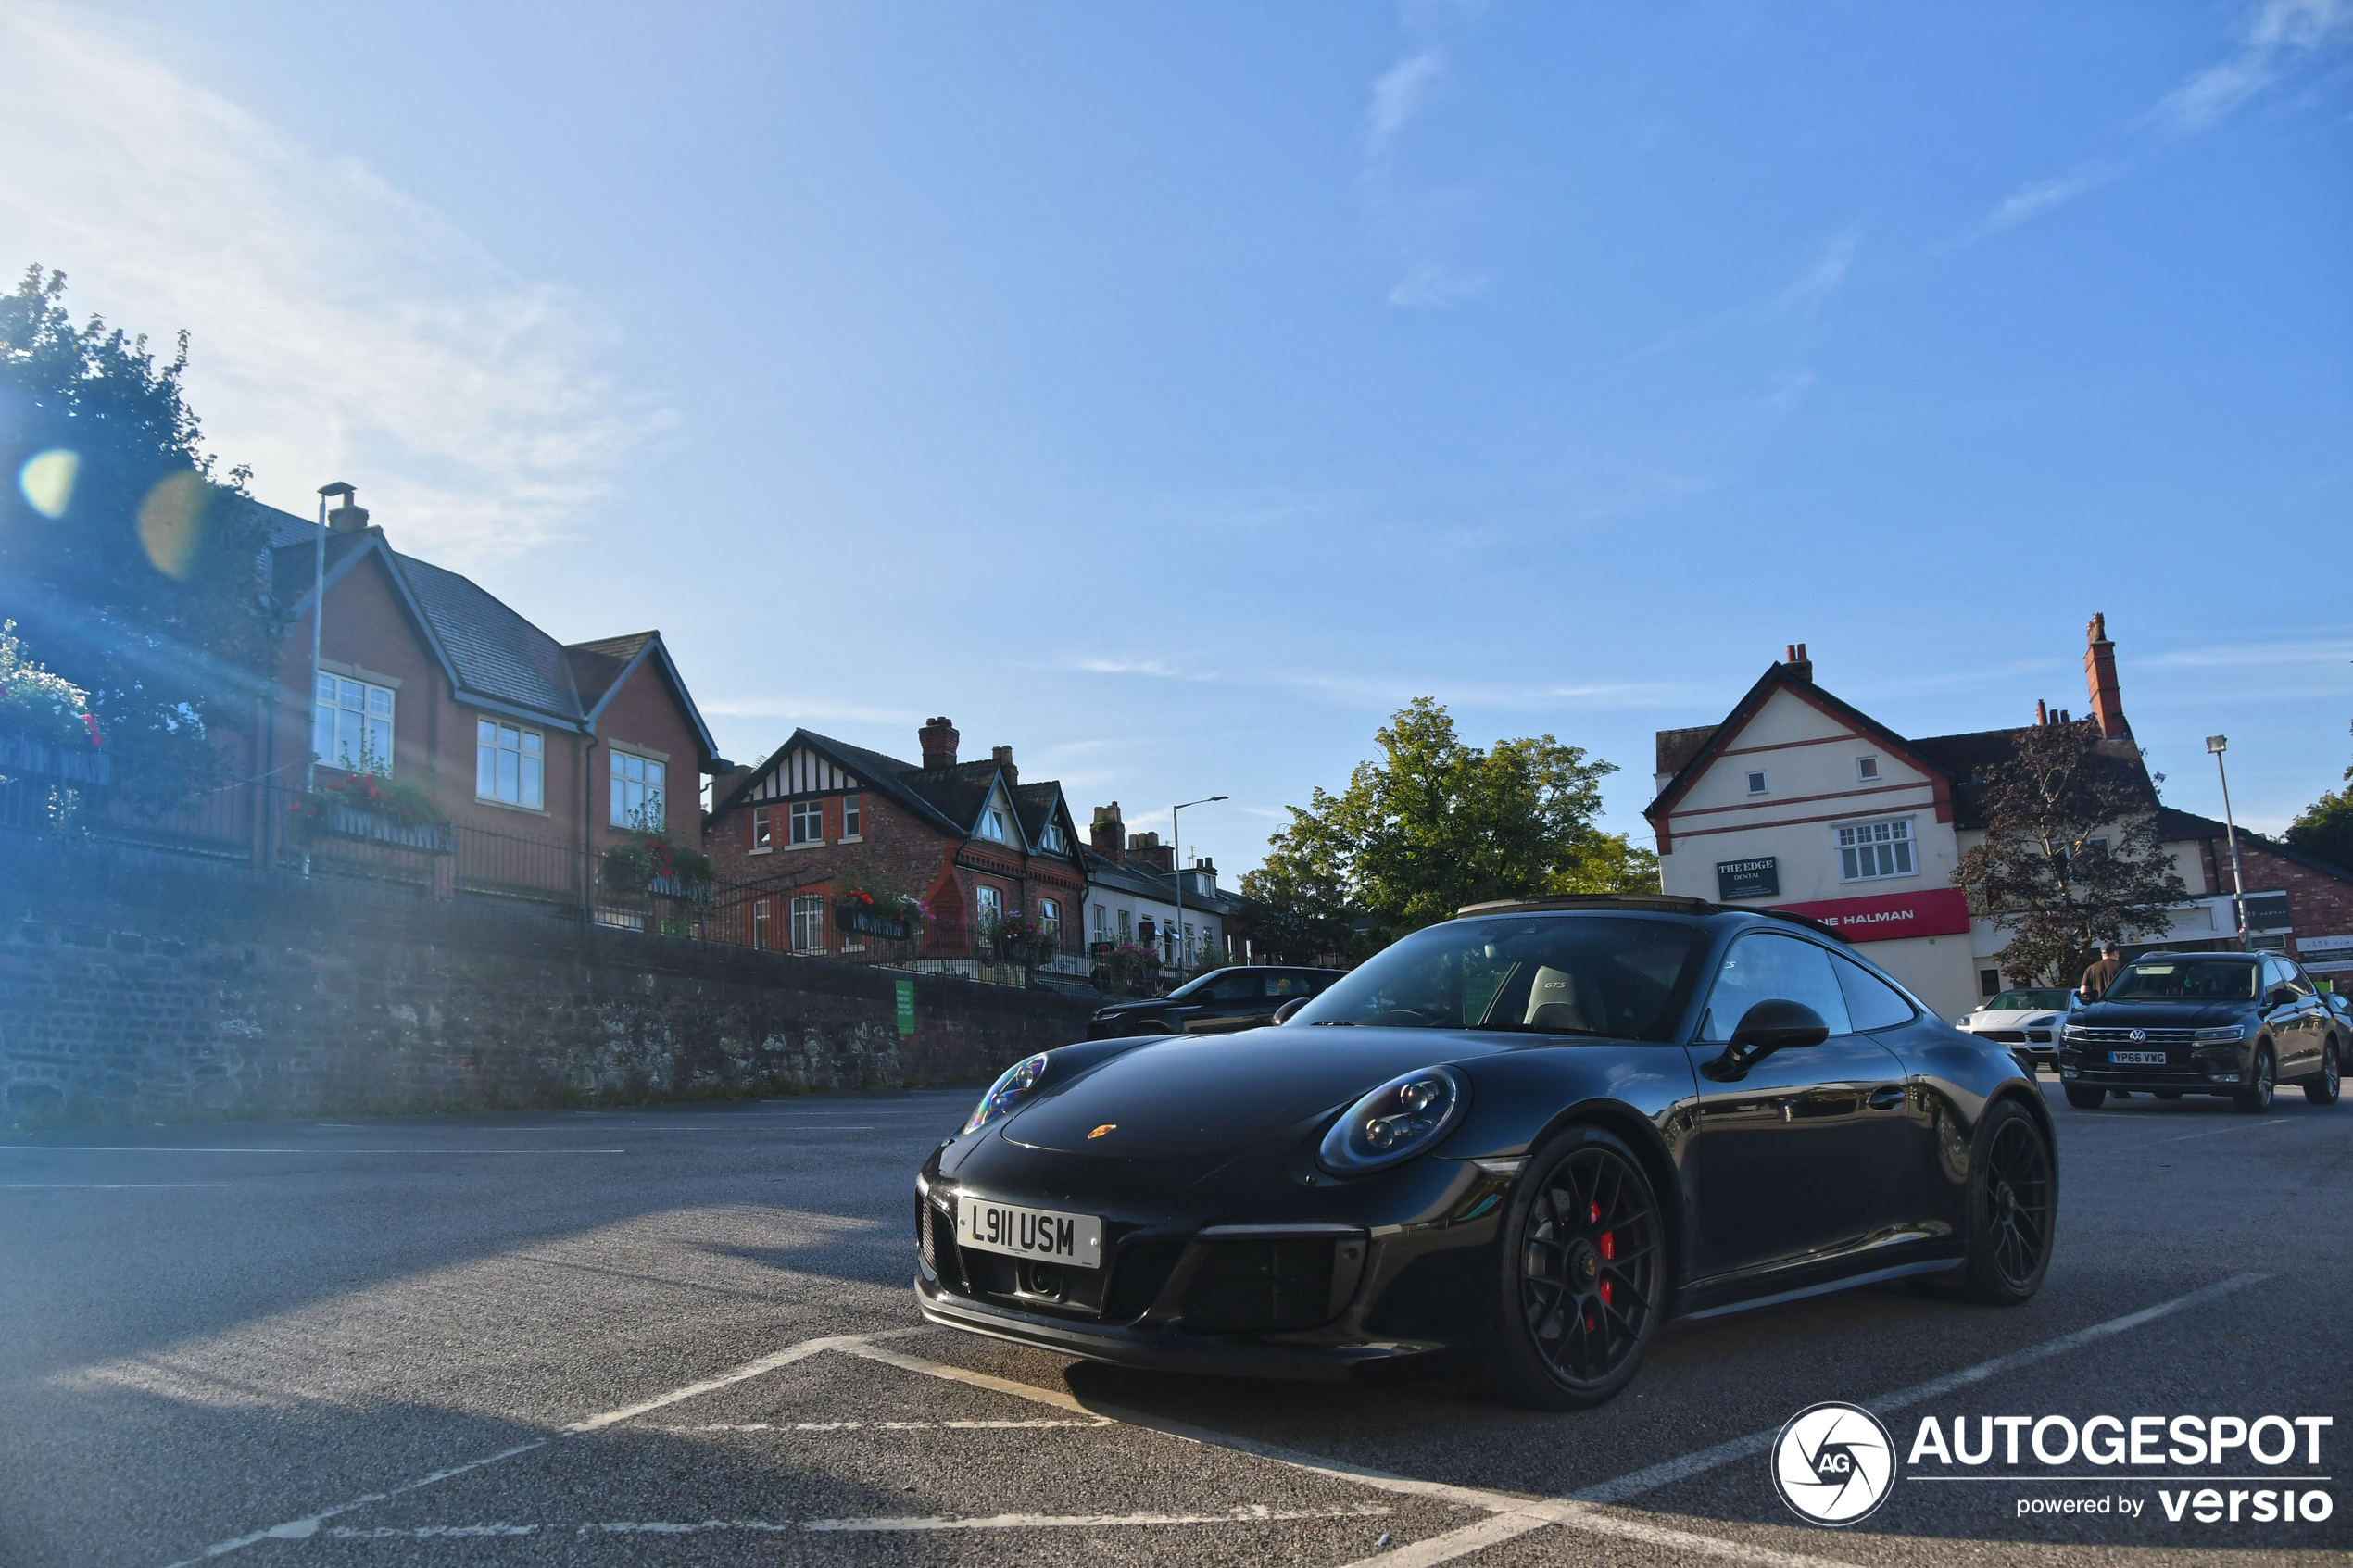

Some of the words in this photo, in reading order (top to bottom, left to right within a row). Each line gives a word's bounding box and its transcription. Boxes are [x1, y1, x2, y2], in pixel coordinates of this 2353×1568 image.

[1718, 863, 1743, 874] THE
[1743, 859, 1773, 872] EDGE
[1733, 872, 1761, 881] DENTAL
[1843, 909, 1914, 925] HALMAN
[2114, 1053, 2142, 1062] YP66
[2144, 1053, 2164, 1062] VWG
[1020, 1212, 1074, 1257] USM
